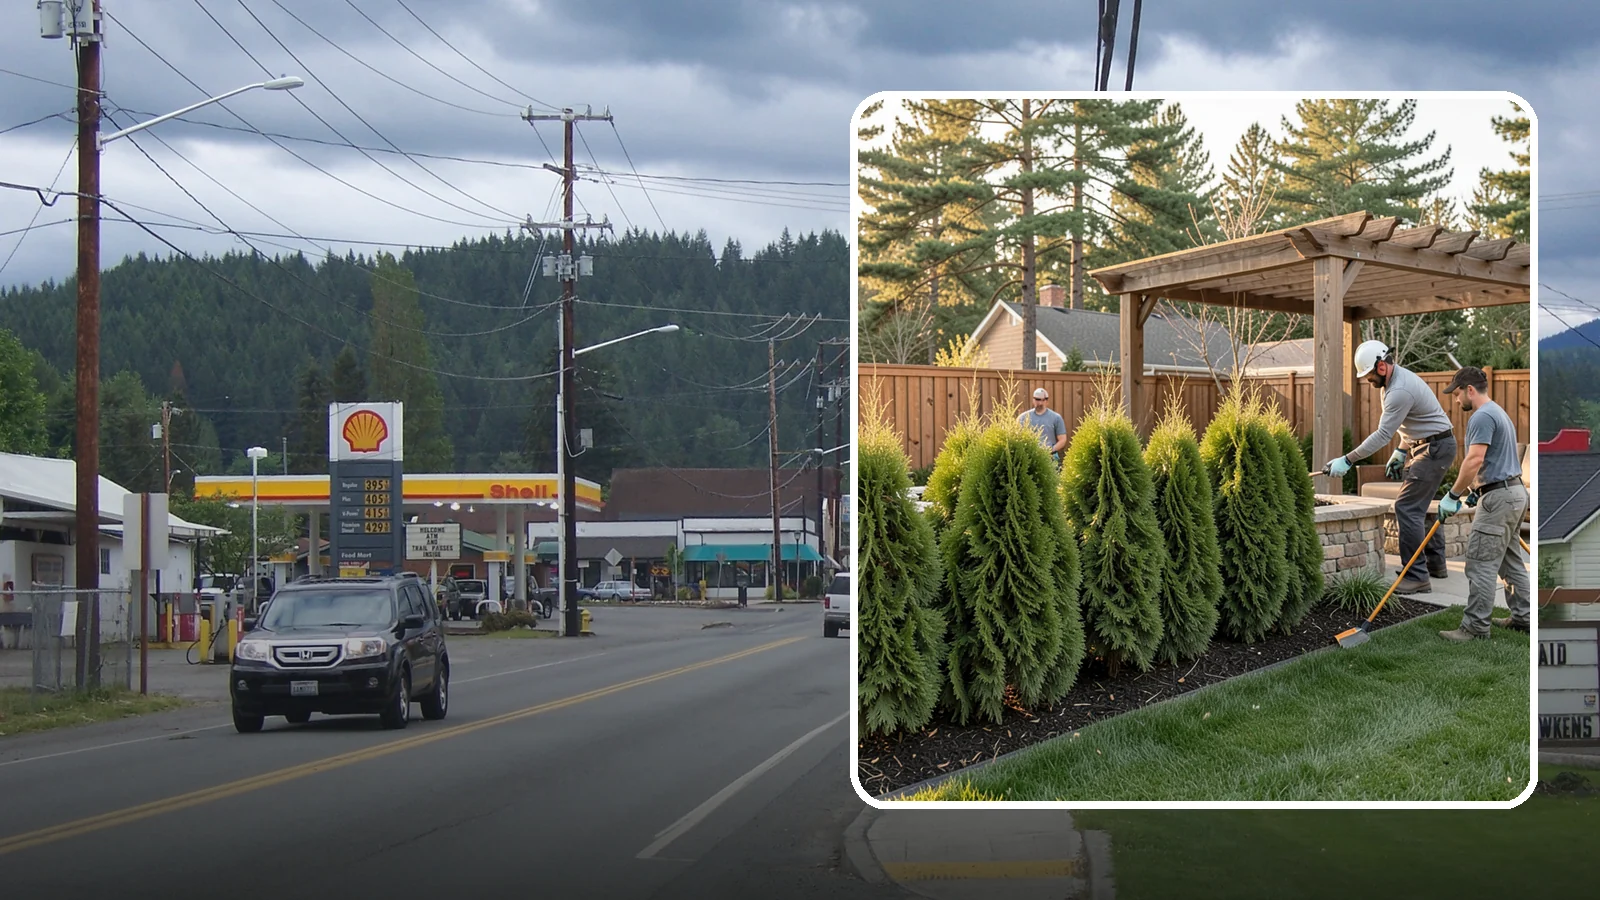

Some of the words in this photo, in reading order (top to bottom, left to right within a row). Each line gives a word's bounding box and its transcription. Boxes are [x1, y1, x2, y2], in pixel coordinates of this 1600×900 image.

[365, 480, 384, 490] 395
[490, 484, 547, 499] Shell
[365, 494, 384, 504] 405
[365, 508, 384, 518] 415
[365, 522, 384, 532] 429
